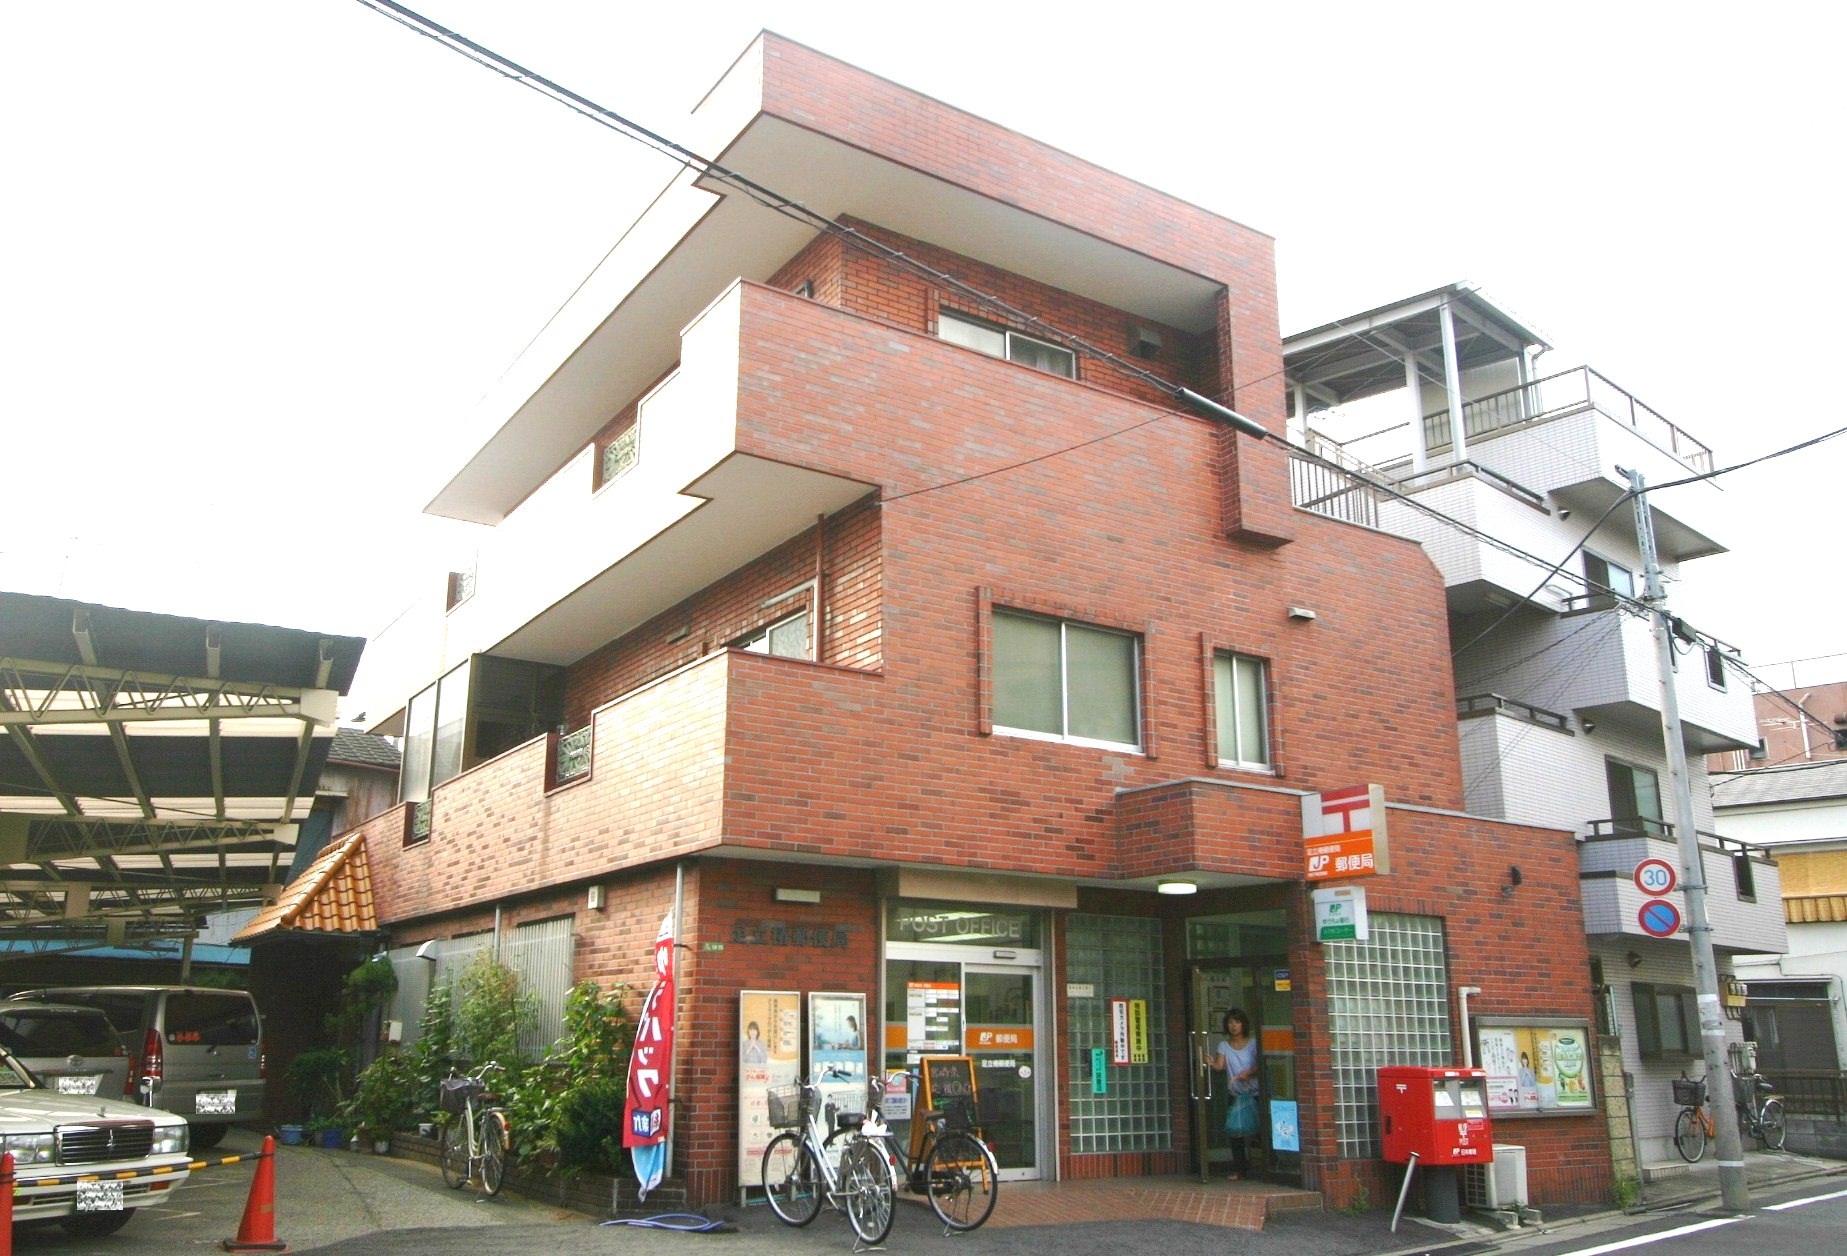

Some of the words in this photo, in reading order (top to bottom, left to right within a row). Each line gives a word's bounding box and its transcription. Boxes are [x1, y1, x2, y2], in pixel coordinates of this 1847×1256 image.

[1335, 853, 1374, 872] 郵便局
[1644, 869, 1668, 886] 30
[899, 915, 949, 934] POST
[955, 917, 1020, 938] OFFICE
[995, 1033, 1018, 1044] 郵便局
